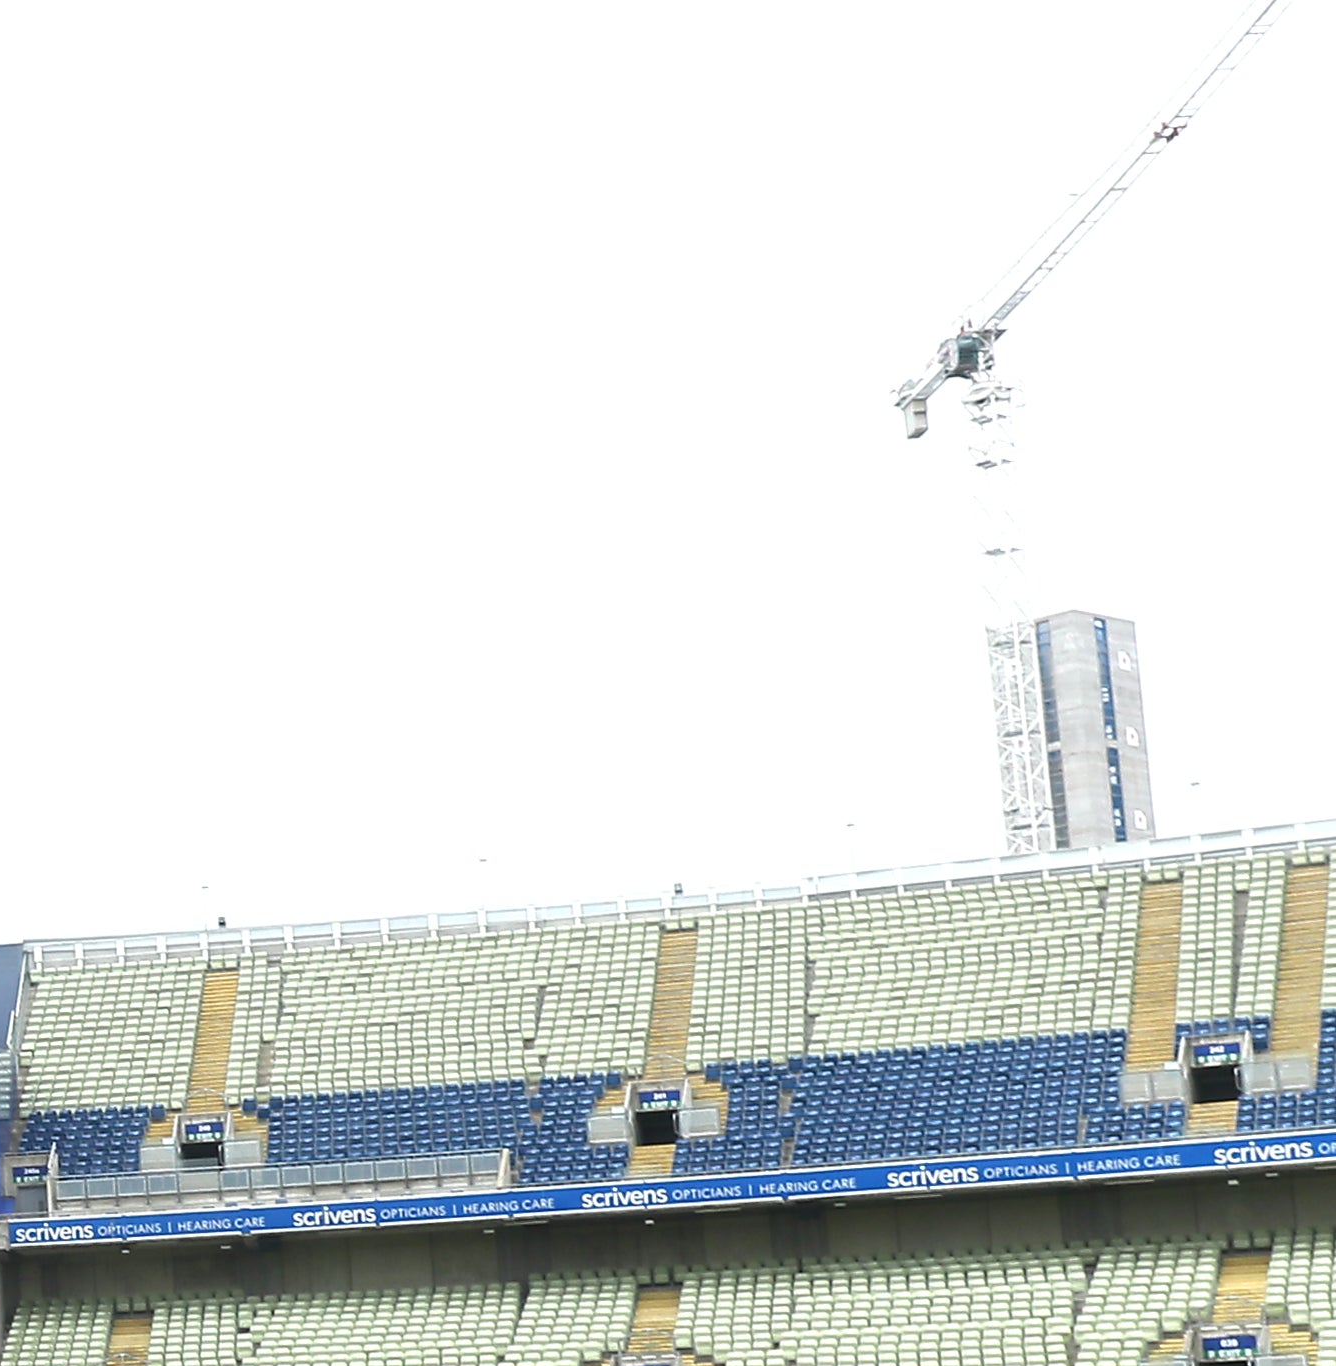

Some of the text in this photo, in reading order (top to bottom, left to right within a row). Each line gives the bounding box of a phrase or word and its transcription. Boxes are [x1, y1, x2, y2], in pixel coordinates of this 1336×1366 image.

[1214, 1141, 1313, 1165] scrivens
[886, 1154, 1180, 1188] scrivens OPTICIANS HEARING CARE
[581, 1177, 857, 1209] scrivens OPTICIANS HEARING CARE
[293, 1198, 555, 1227] scrivens OPTICIANS HEARING CARE
[15, 1216, 266, 1243] scrivens OPTICIANS HEARING CARE
